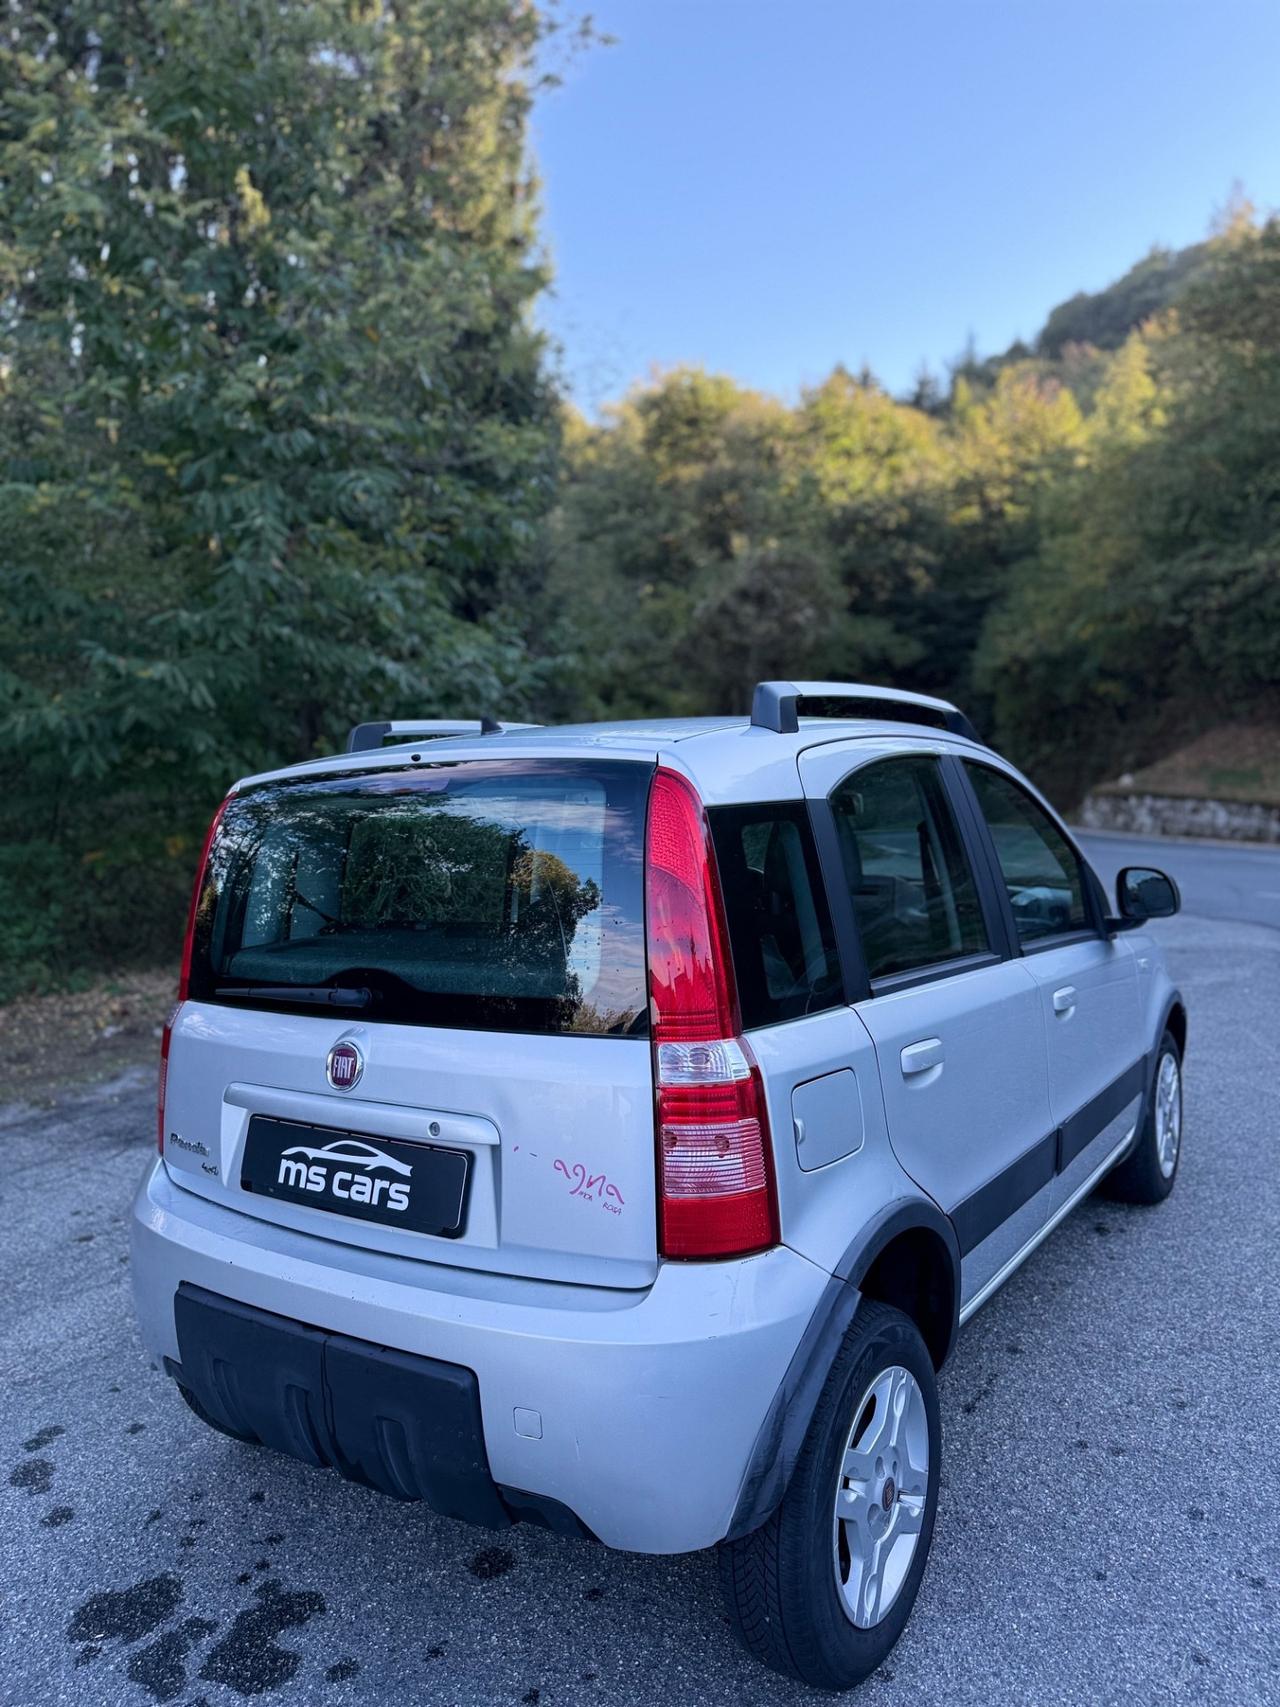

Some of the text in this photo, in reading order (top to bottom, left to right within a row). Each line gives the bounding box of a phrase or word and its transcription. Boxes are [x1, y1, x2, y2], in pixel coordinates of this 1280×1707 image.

[332, 1055, 355, 1079] FIAT
[278, 1158, 411, 1211] ms cars
